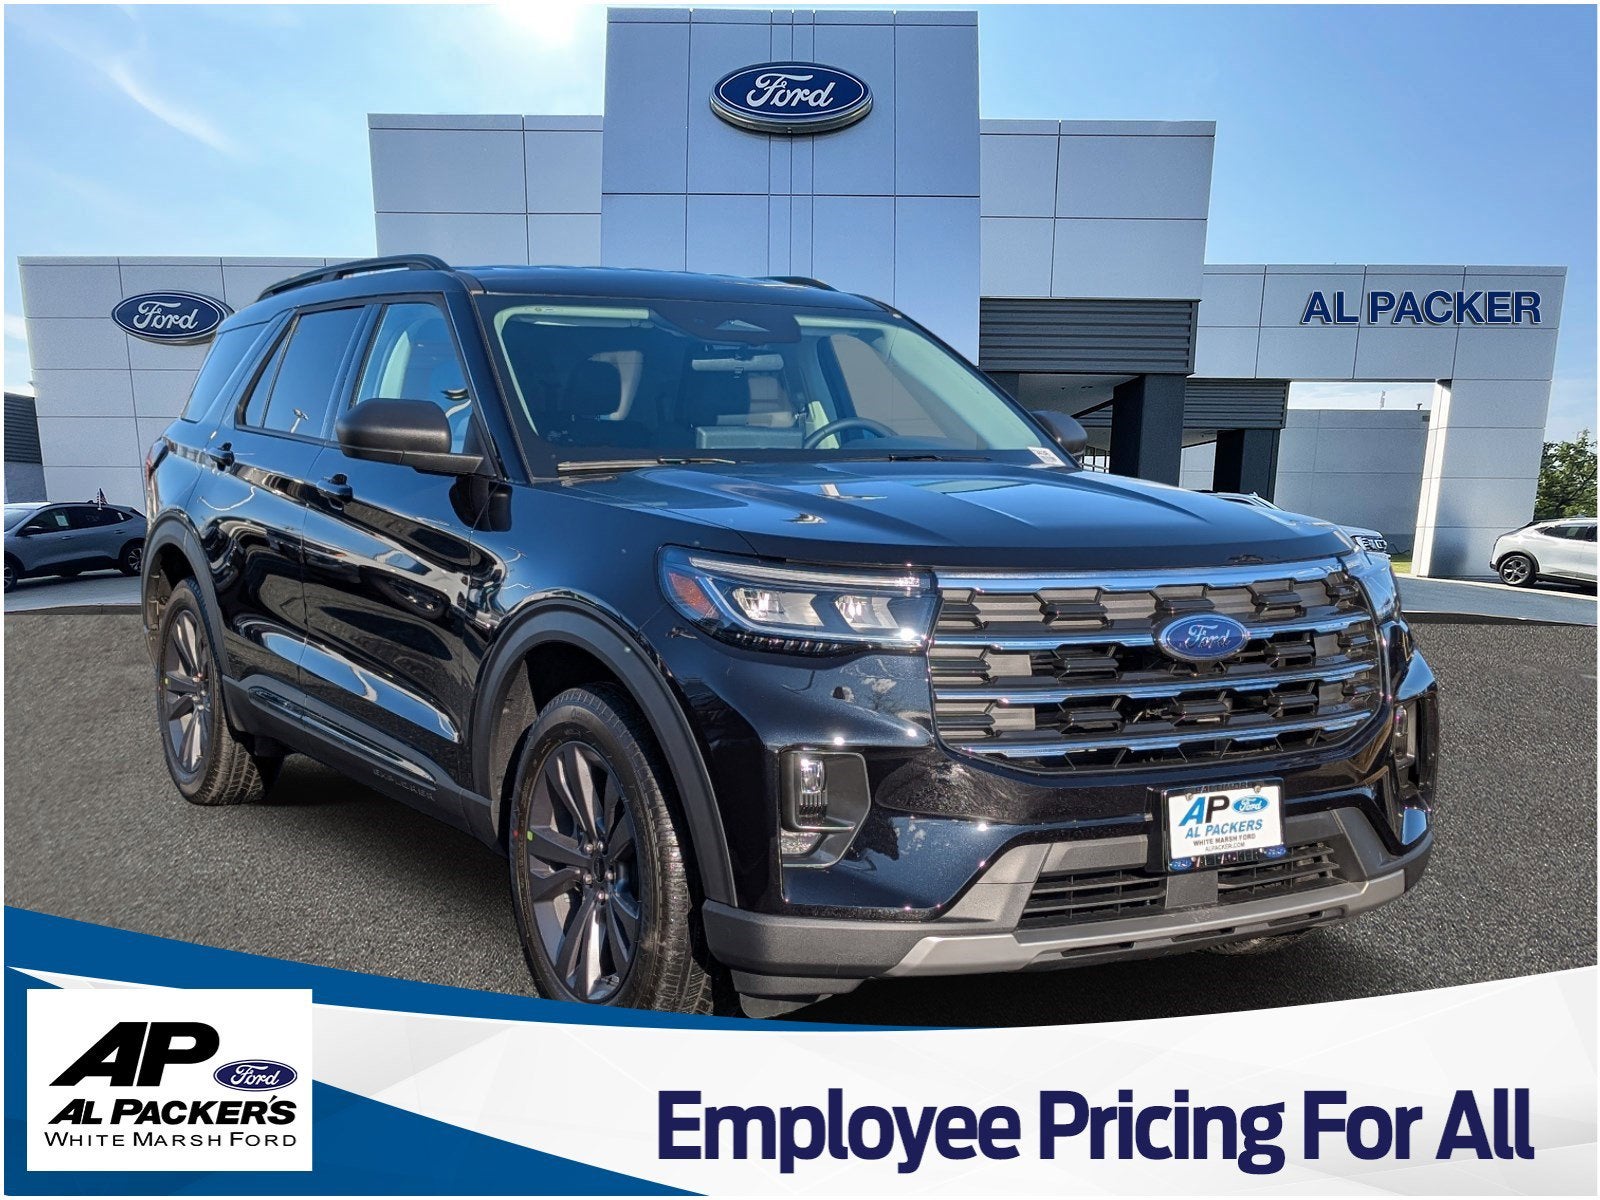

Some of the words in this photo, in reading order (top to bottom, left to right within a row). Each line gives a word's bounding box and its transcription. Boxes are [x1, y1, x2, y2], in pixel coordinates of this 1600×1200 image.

[746, 73, 836, 108] Ford
[133, 301, 199, 329] Ford
[1302, 290, 1359, 324] AL
[1368, 290, 1542, 325] PACKER
[1184, 624, 1231, 649] Ford
[1178, 794, 1230, 827] AP
[1239, 798, 1263, 812] Ford
[1185, 826, 1201, 839] AL
[1205, 818, 1263, 837] PACKERS
[1193, 838, 1214, 847] WHITE
[1215, 834, 1238, 844] MARSH
[1239, 833, 1256, 842] FORD
